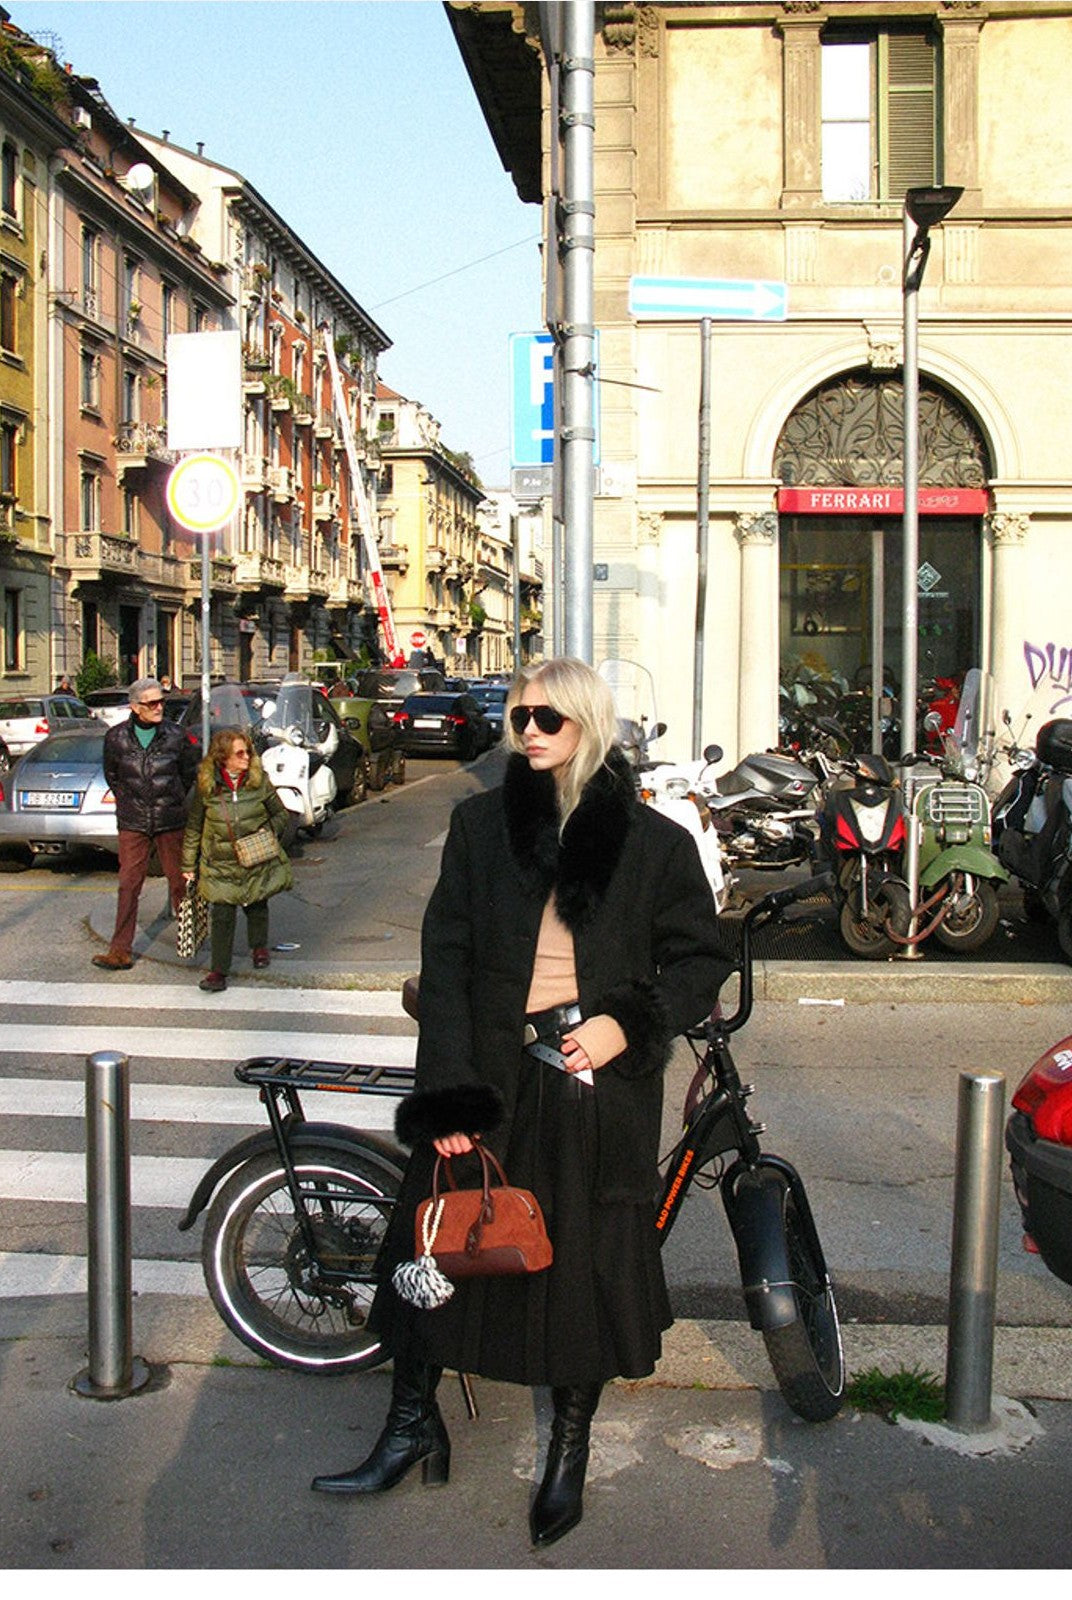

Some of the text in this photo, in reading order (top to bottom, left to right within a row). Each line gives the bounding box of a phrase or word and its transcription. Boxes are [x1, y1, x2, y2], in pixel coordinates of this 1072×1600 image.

[188, 478, 223, 508] 30
[811, 493, 890, 509] FERRARI
[664, 1176, 683, 1210] POWER
[678, 1149, 695, 1177] BIKES
